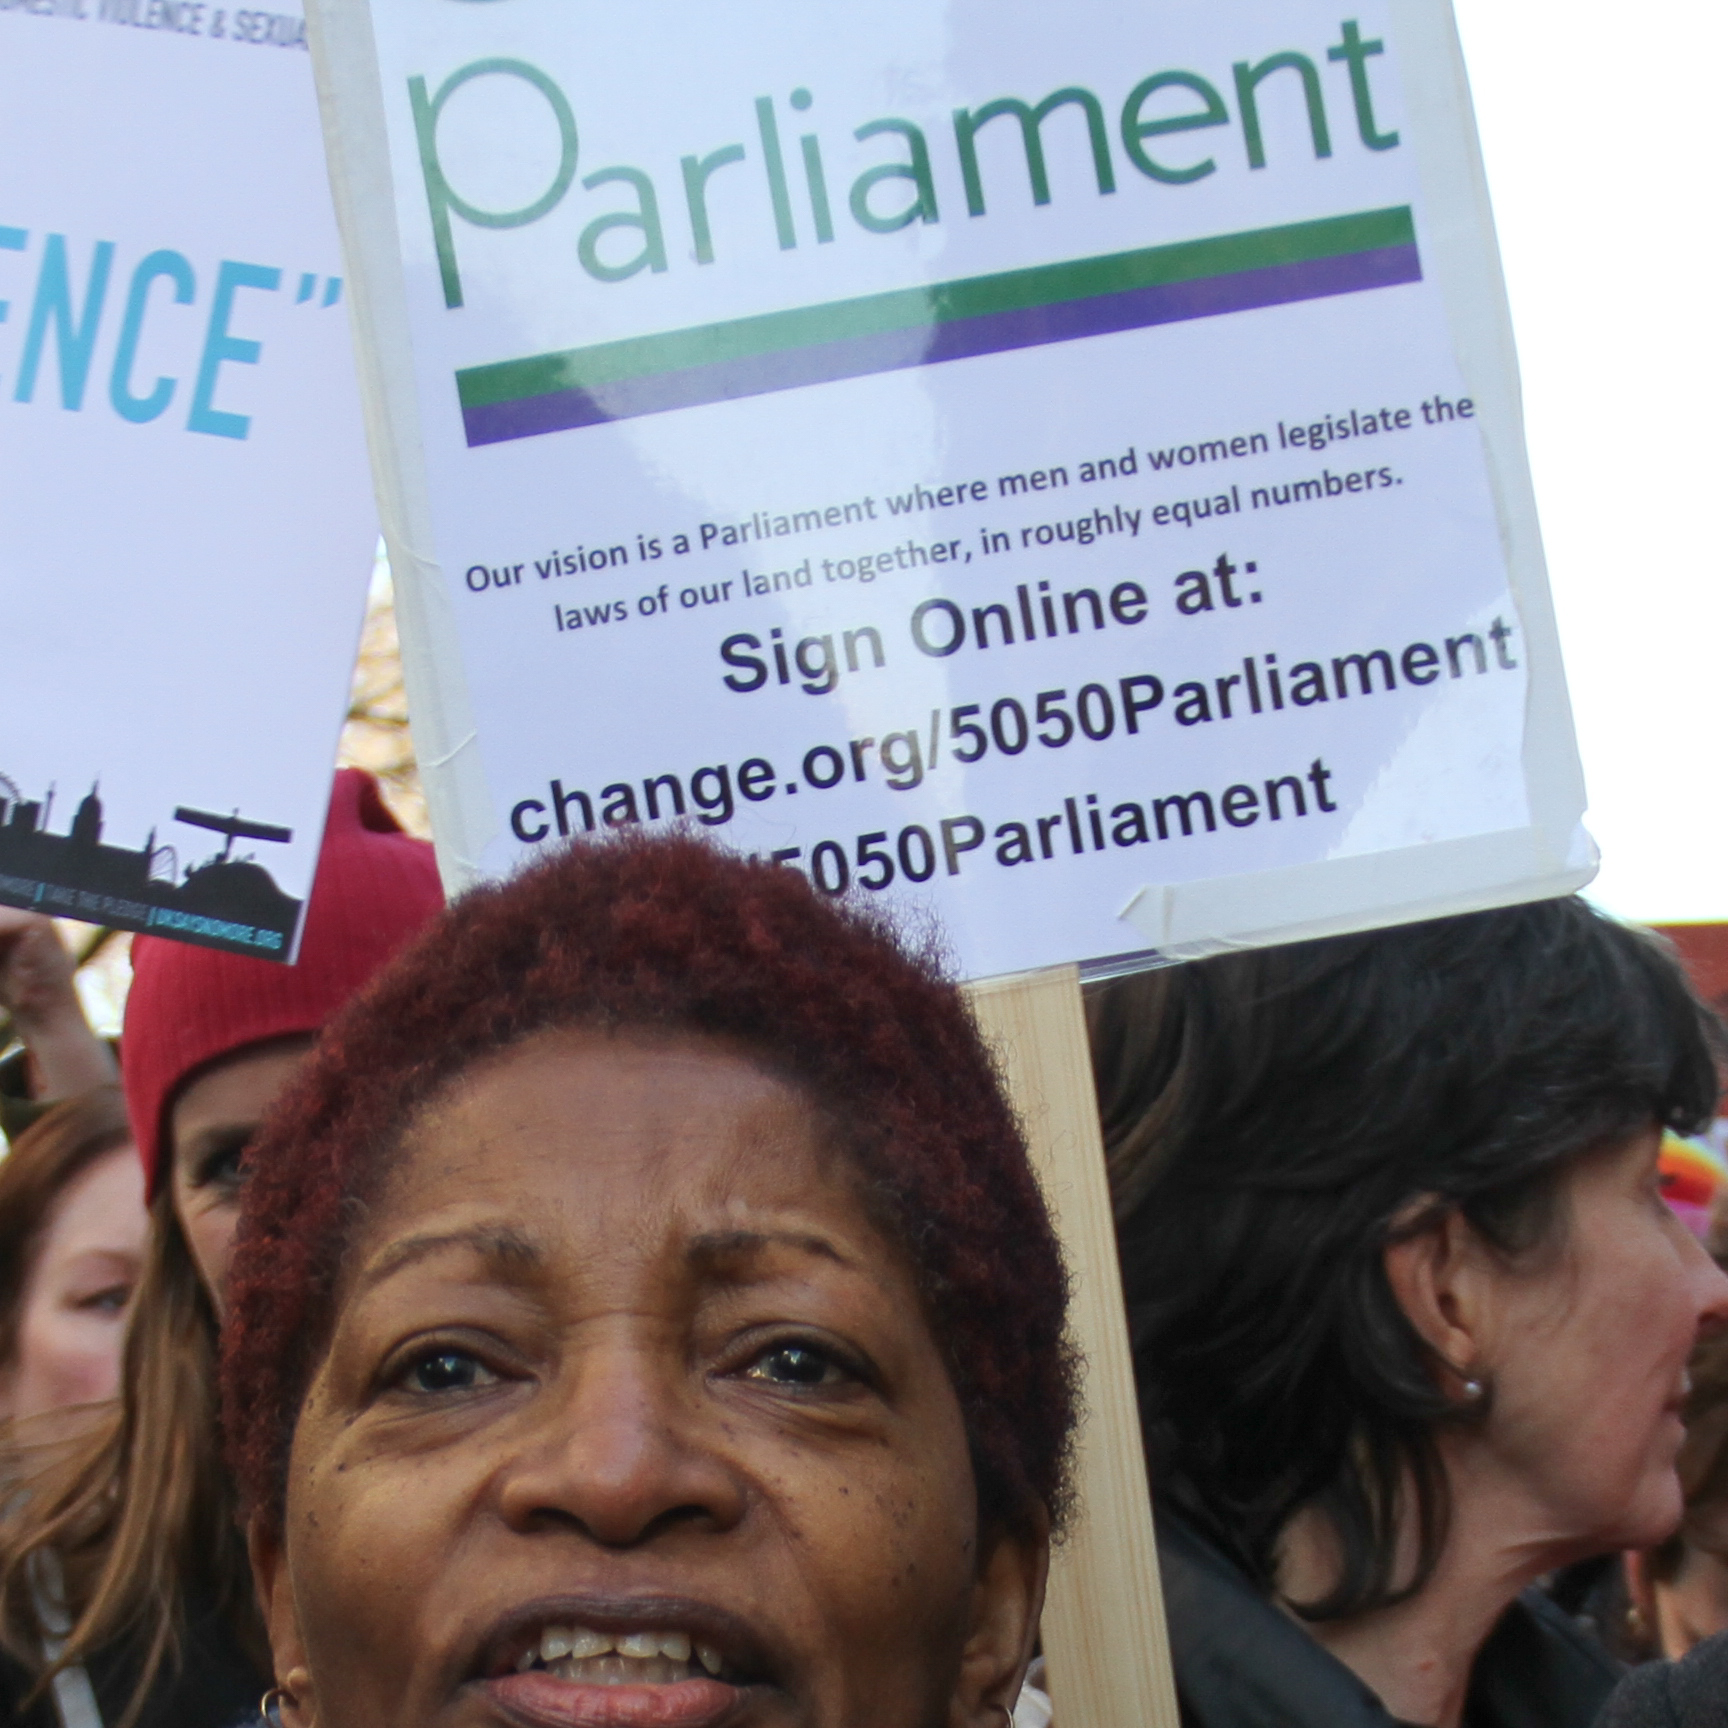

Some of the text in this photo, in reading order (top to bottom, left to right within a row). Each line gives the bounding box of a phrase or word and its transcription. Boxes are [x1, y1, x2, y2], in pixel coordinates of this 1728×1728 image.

[407, 19, 1401, 310] Parliament
[465, 394, 1475, 593] Our vision is a Parliament where men and women legislate the
[554, 467, 1403, 632] laws of our land together, in roughly equal numbers.
[719, 552, 1264, 696] Sign Online at:
[510, 615, 1518, 843] change.org/5050Parliament
